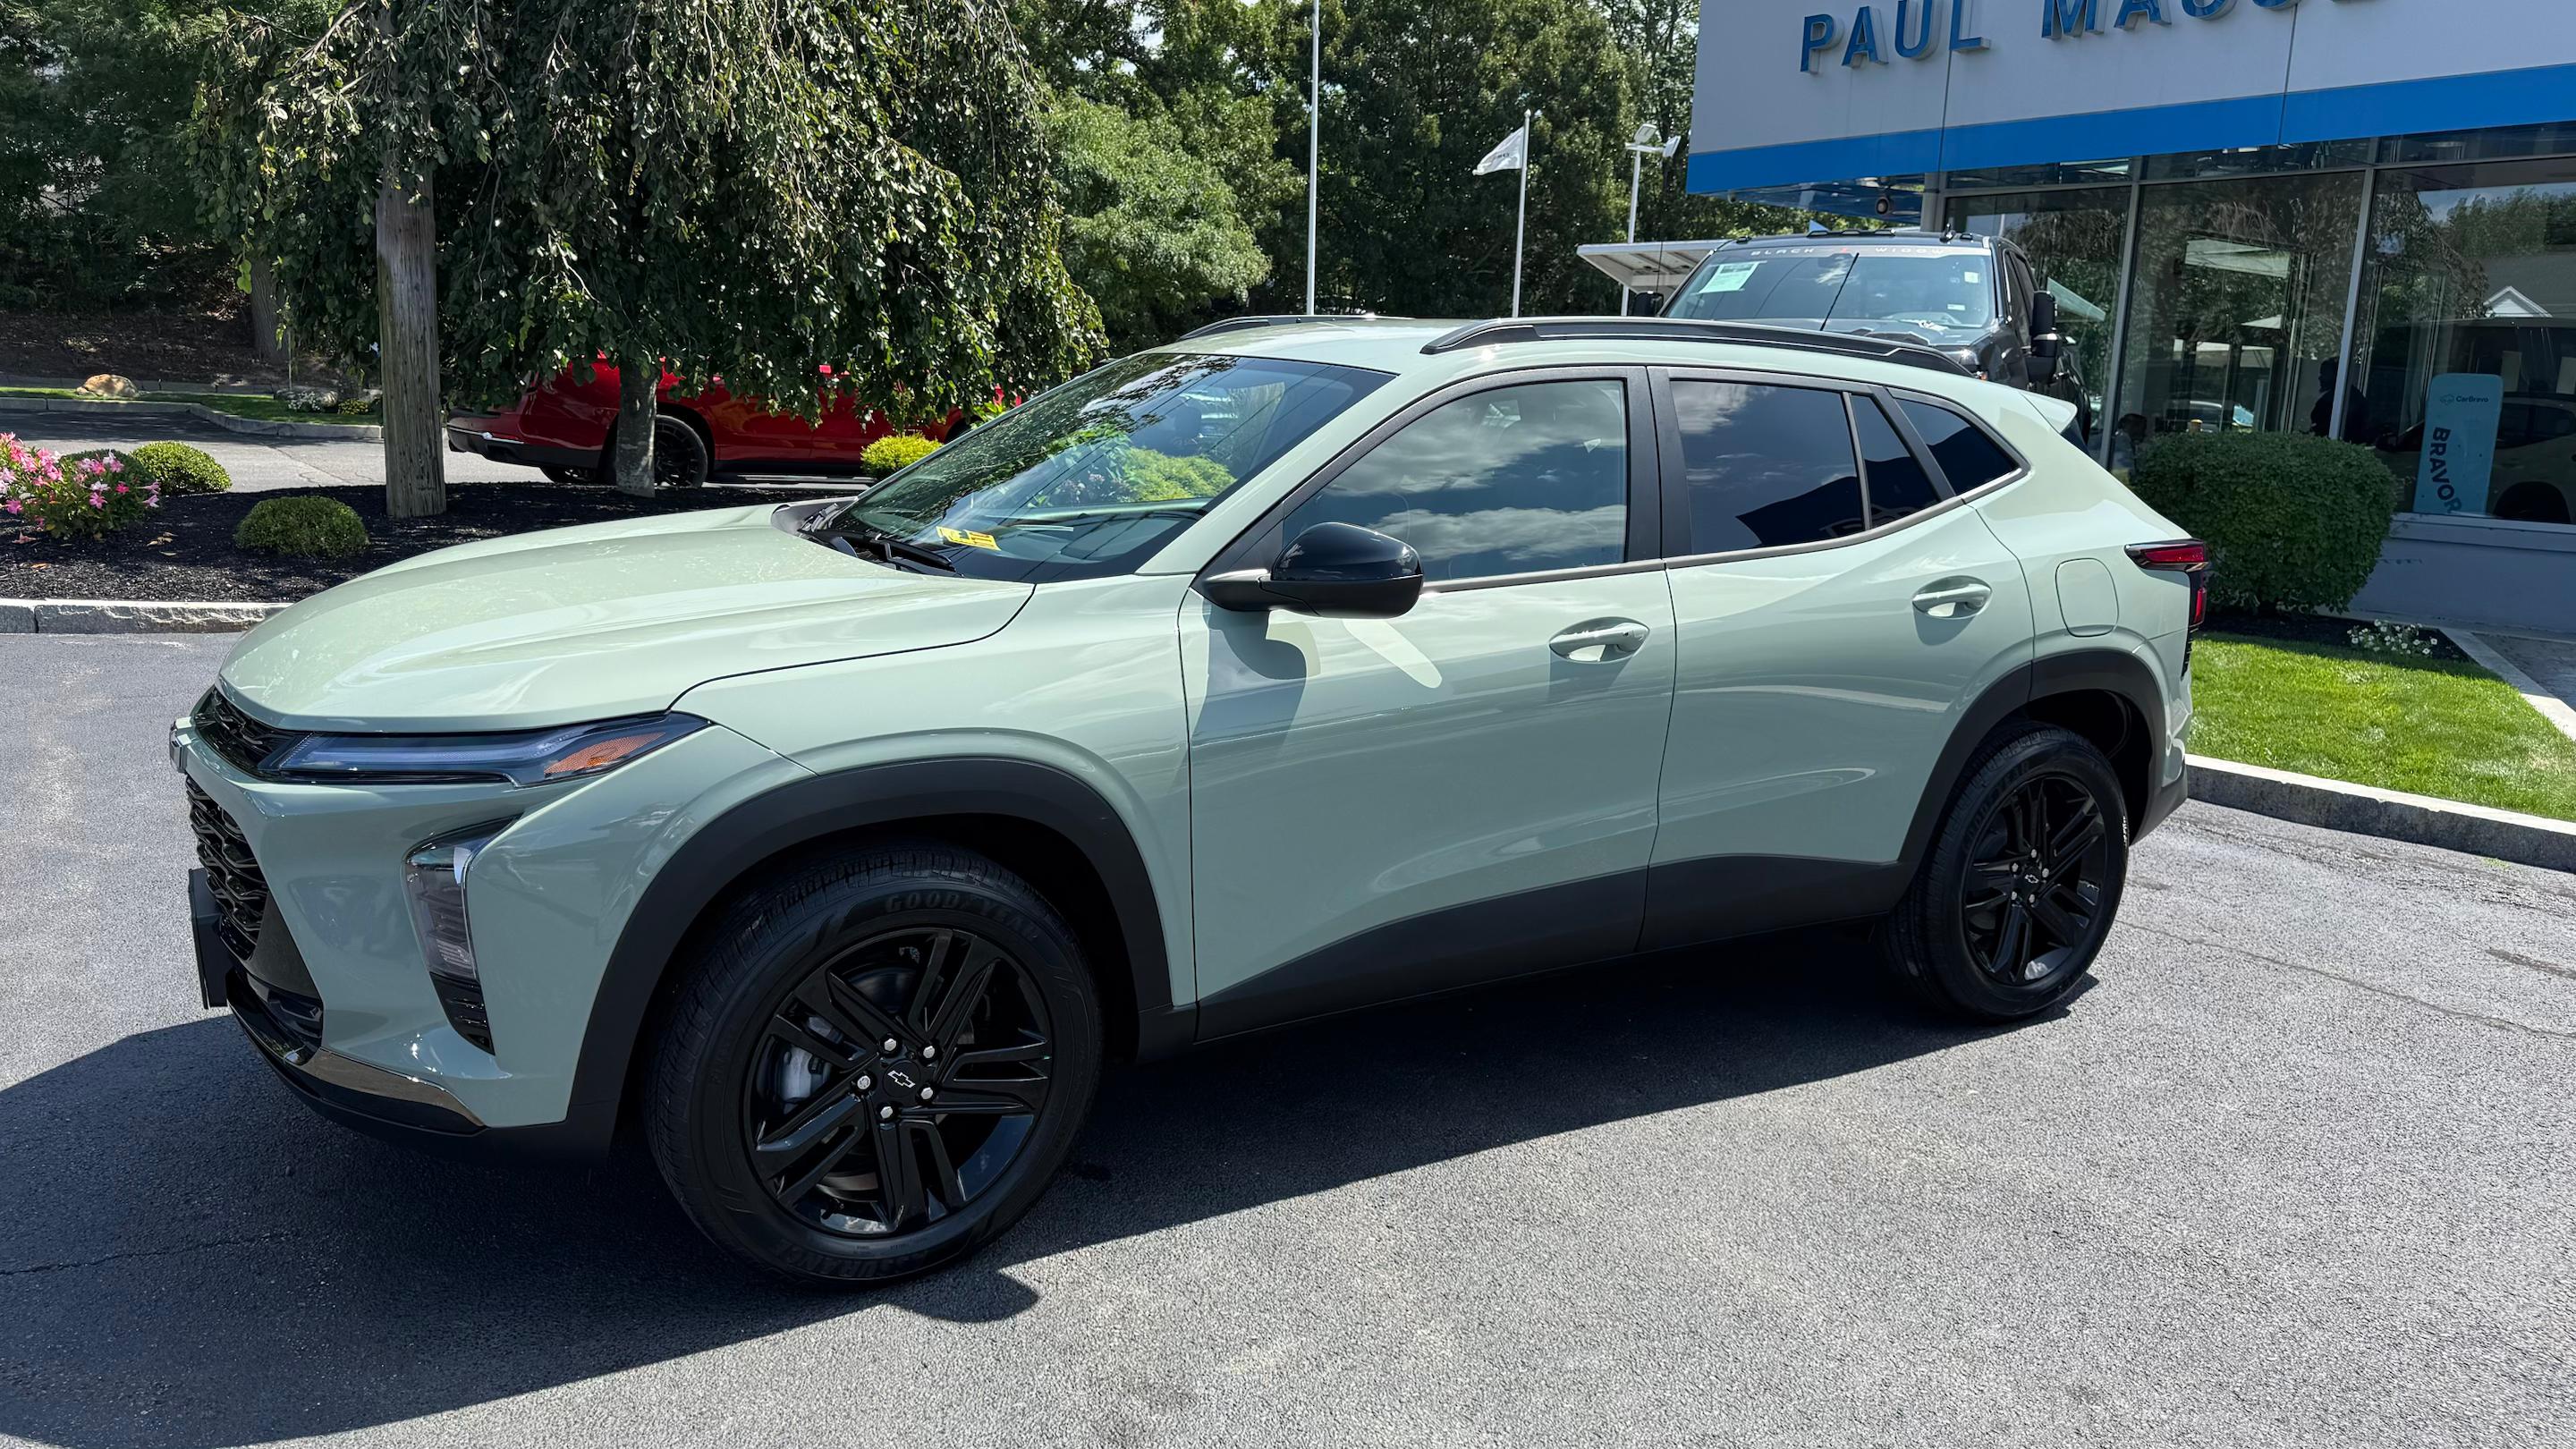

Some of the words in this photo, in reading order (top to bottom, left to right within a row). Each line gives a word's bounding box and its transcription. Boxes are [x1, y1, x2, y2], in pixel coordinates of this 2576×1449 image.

[1801, 0, 1989, 73] PAUL
[1750, 248, 1815, 256] BLACK
[2455, 394, 2489, 402] CarBravo
